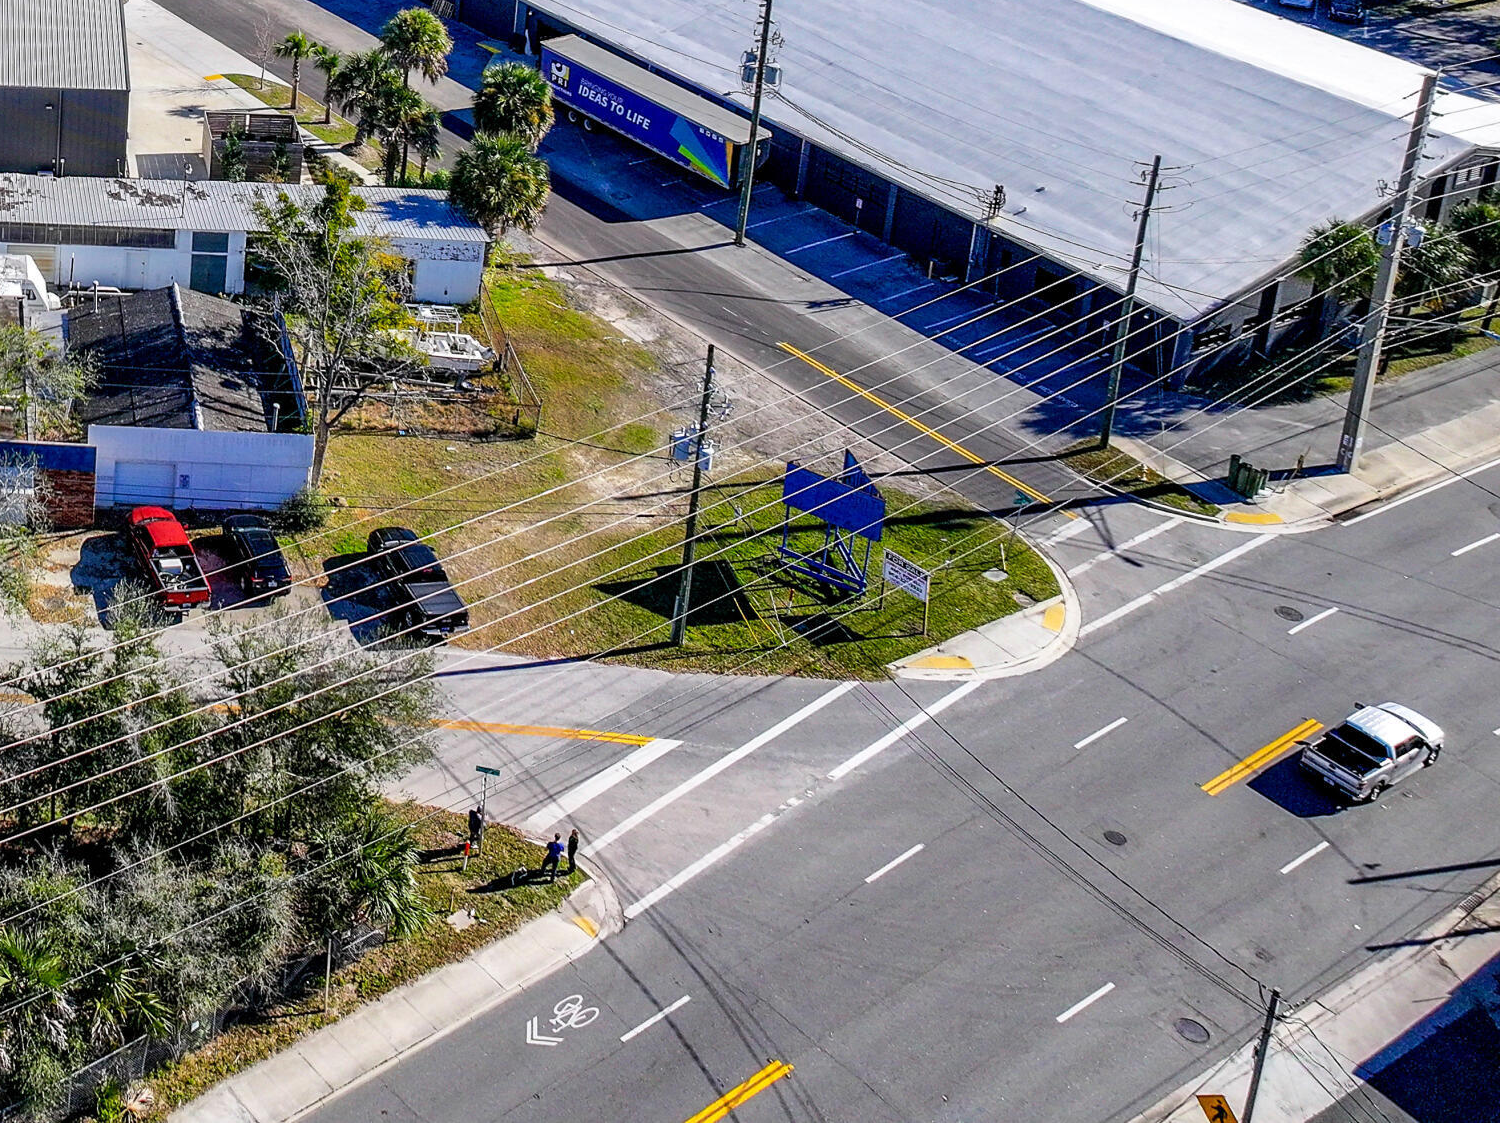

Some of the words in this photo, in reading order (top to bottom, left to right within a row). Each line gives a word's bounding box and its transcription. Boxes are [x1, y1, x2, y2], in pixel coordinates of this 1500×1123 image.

[551, 74, 568, 88] PRI
[578, 84, 608, 107] IDEAS
[610, 100, 624, 116] TO
[626, 109, 651, 130] LIFE
[888, 554, 904, 566] FOR
